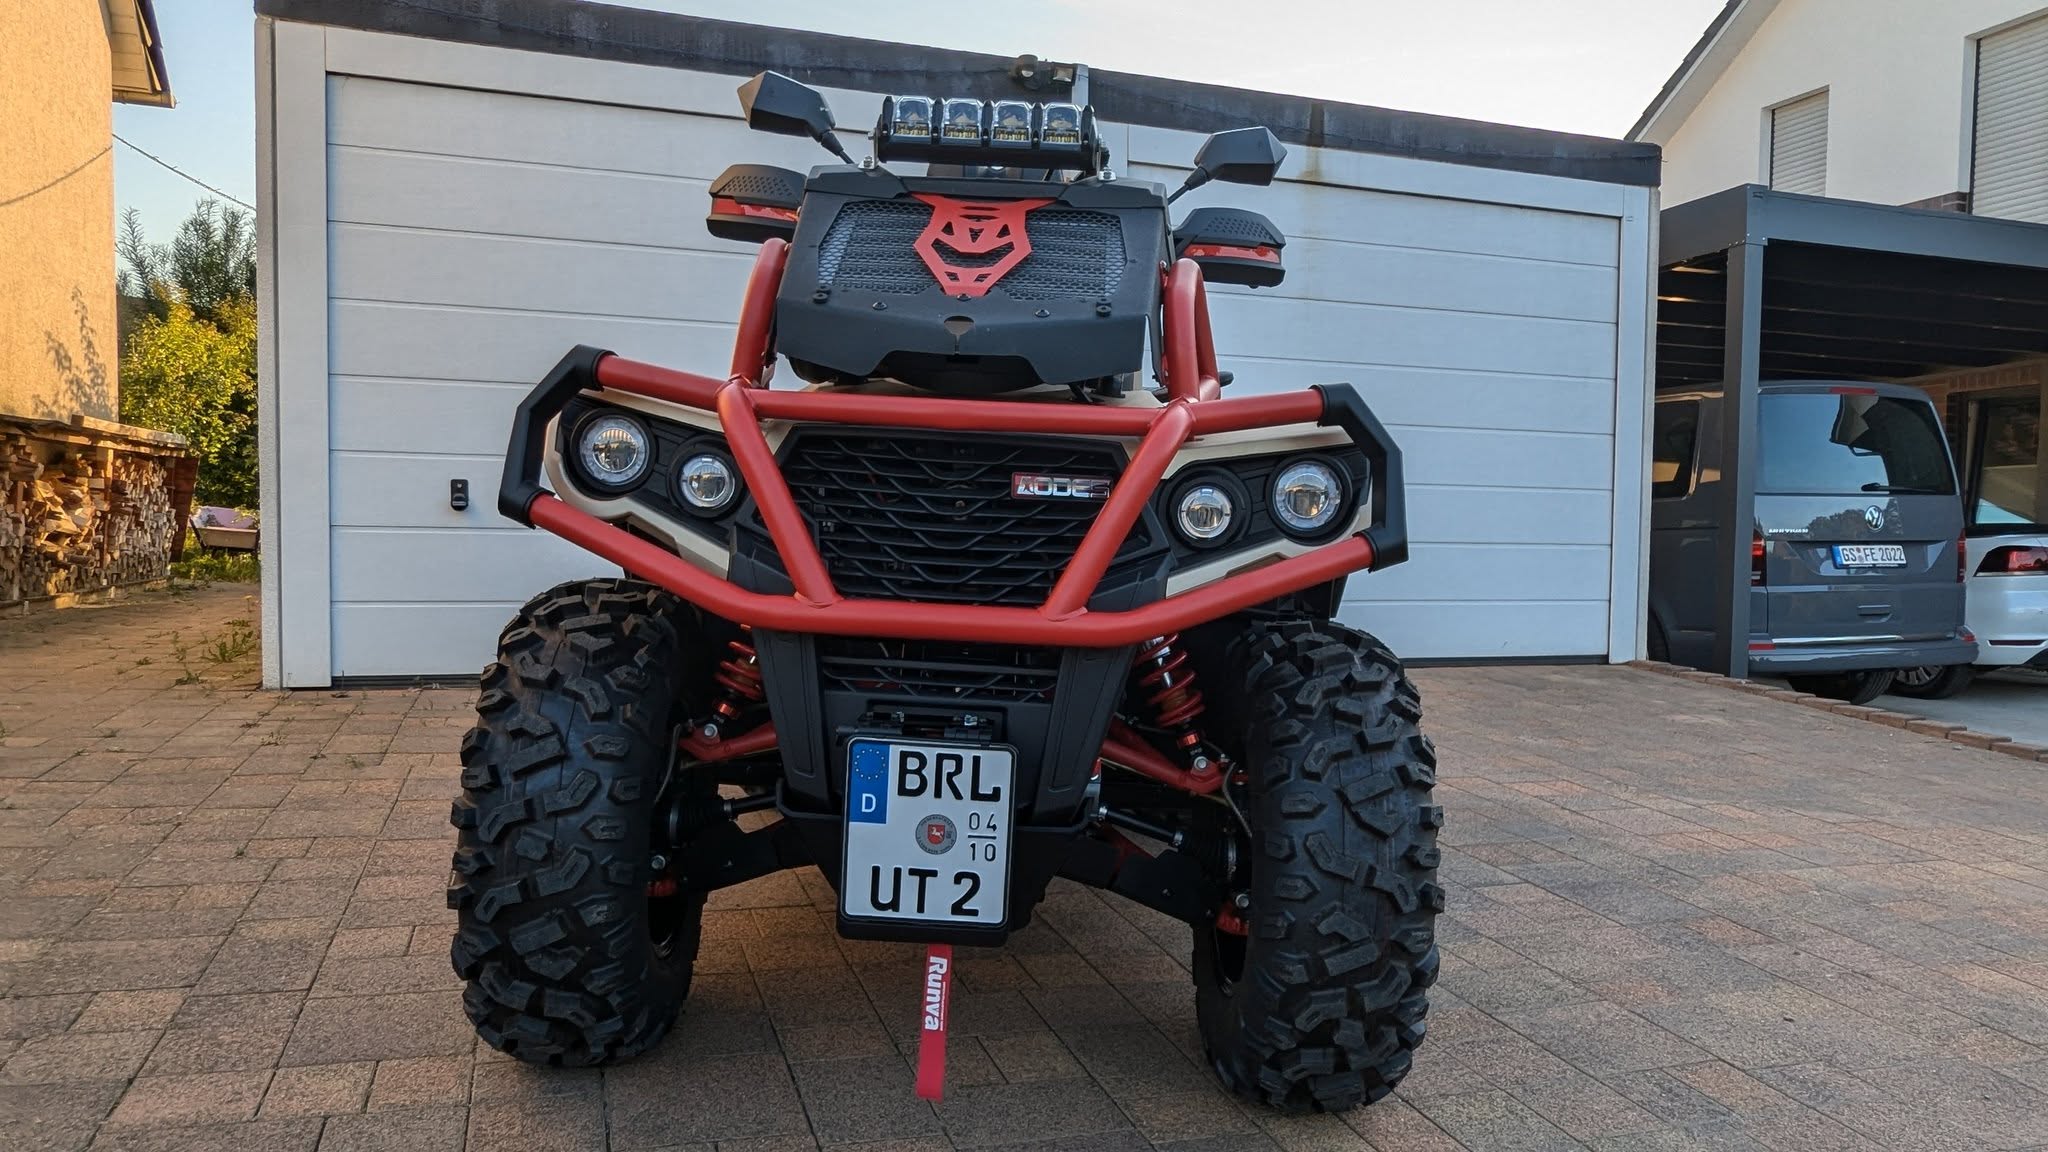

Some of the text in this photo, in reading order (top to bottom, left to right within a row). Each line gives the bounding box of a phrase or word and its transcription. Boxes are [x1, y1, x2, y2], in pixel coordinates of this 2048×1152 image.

[1016, 475, 1110, 498] AODES
[1841, 547, 1905, 562] GS FE 2022
[897, 750, 1001, 802] BRL
[861, 793, 877, 813] D
[968, 812, 998, 832] 04
[969, 842, 996, 862] 10
[870, 865, 981, 917] UT 2
[924, 955, 948, 1031] Runva
